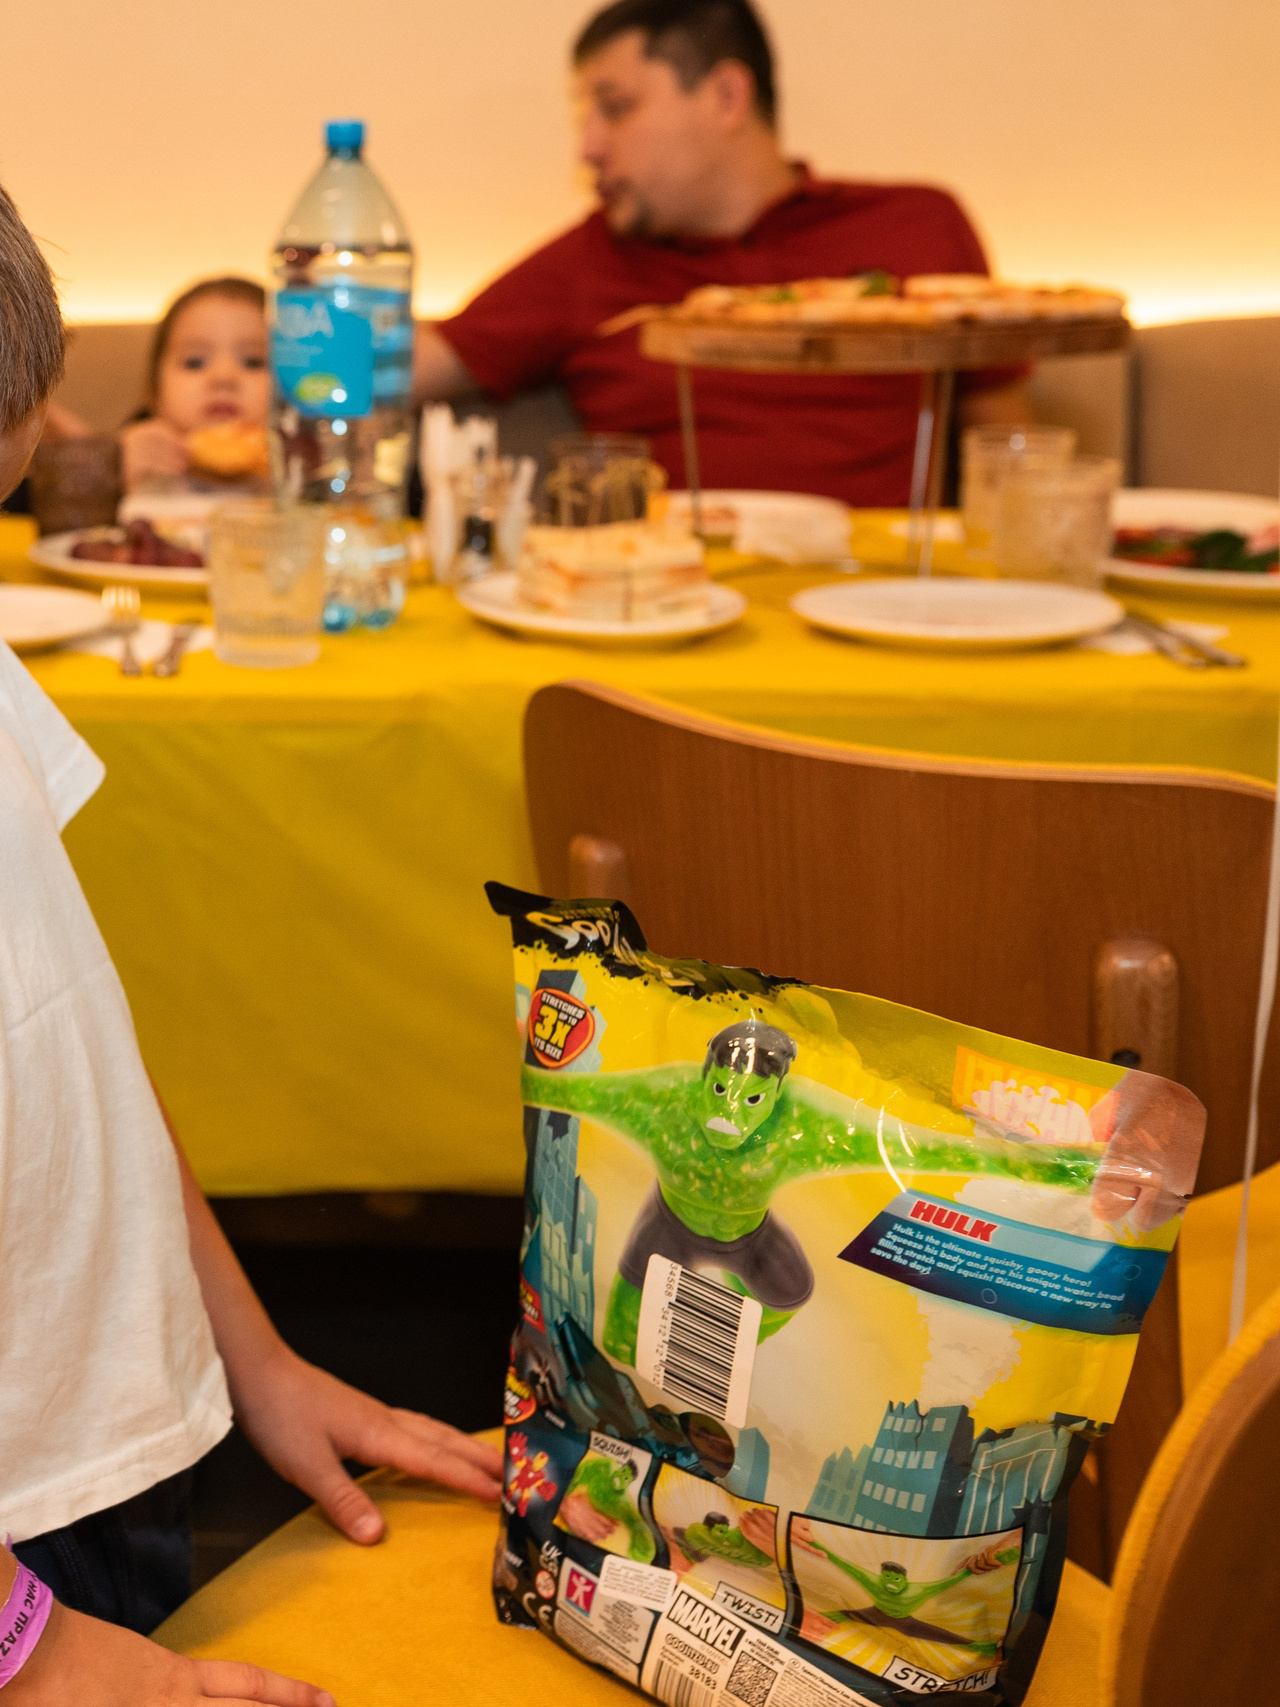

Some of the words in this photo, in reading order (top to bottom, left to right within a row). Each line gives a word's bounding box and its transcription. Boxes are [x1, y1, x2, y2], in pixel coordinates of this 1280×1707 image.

[541, 991, 587, 1020] STRETCHES
[558, 1011, 568, 1020] UP
[567, 1017, 578, 1026] TO
[534, 1004, 573, 1049] 3X
[534, 1036, 547, 1051] ITS
[545, 1043, 563, 1060] SIZE
[909, 1199, 999, 1243] HULK
[870, 1247, 892, 1260] save
[892, 1254, 909, 1266] the
[909, 1259, 933, 1275] day!
[885, 1231, 924, 1250] Squeeze
[924, 1244, 938, 1256] his
[939, 1249, 965, 1265] body
[966, 1258, 988, 1271] and
[988, 1266, 1007, 1275] see
[1008, 1268, 1023, 1280] his
[1025, 1276, 1061, 1291] unique
[1063, 1285, 1095, 1298] water
[1096, 1290, 1126, 1302] bead
[892, 1223, 915, 1237] Hulk
[915, 1231, 924, 1240] is
[925, 1232, 941, 1246] the
[941, 1241, 982, 1260] ultimate
[984, 1255, 1025, 1271] squishy,
[1027, 1266, 1061, 1281] gooey
[1063, 1274, 1092, 1287] hero!
[877, 1238, 904, 1256] filling
[904, 1249, 936, 1266] stretch
[936, 1261, 956, 1272] and
[957, 1267, 994, 1283] squish!
[994, 1276, 1039, 1295] Discover
[1049, 1292, 1073, 1303] new
[1075, 1299, 1099, 1310] way
[1099, 1301, 1112, 1309] to
[542, 1540, 562, 1558] UK
[24, 1581, 37, 1610] НАС
[721, 1590, 780, 1627] TWIST!
[668, 1592, 742, 1657] MARVEL
[687, 1664, 718, 1690] 38183
